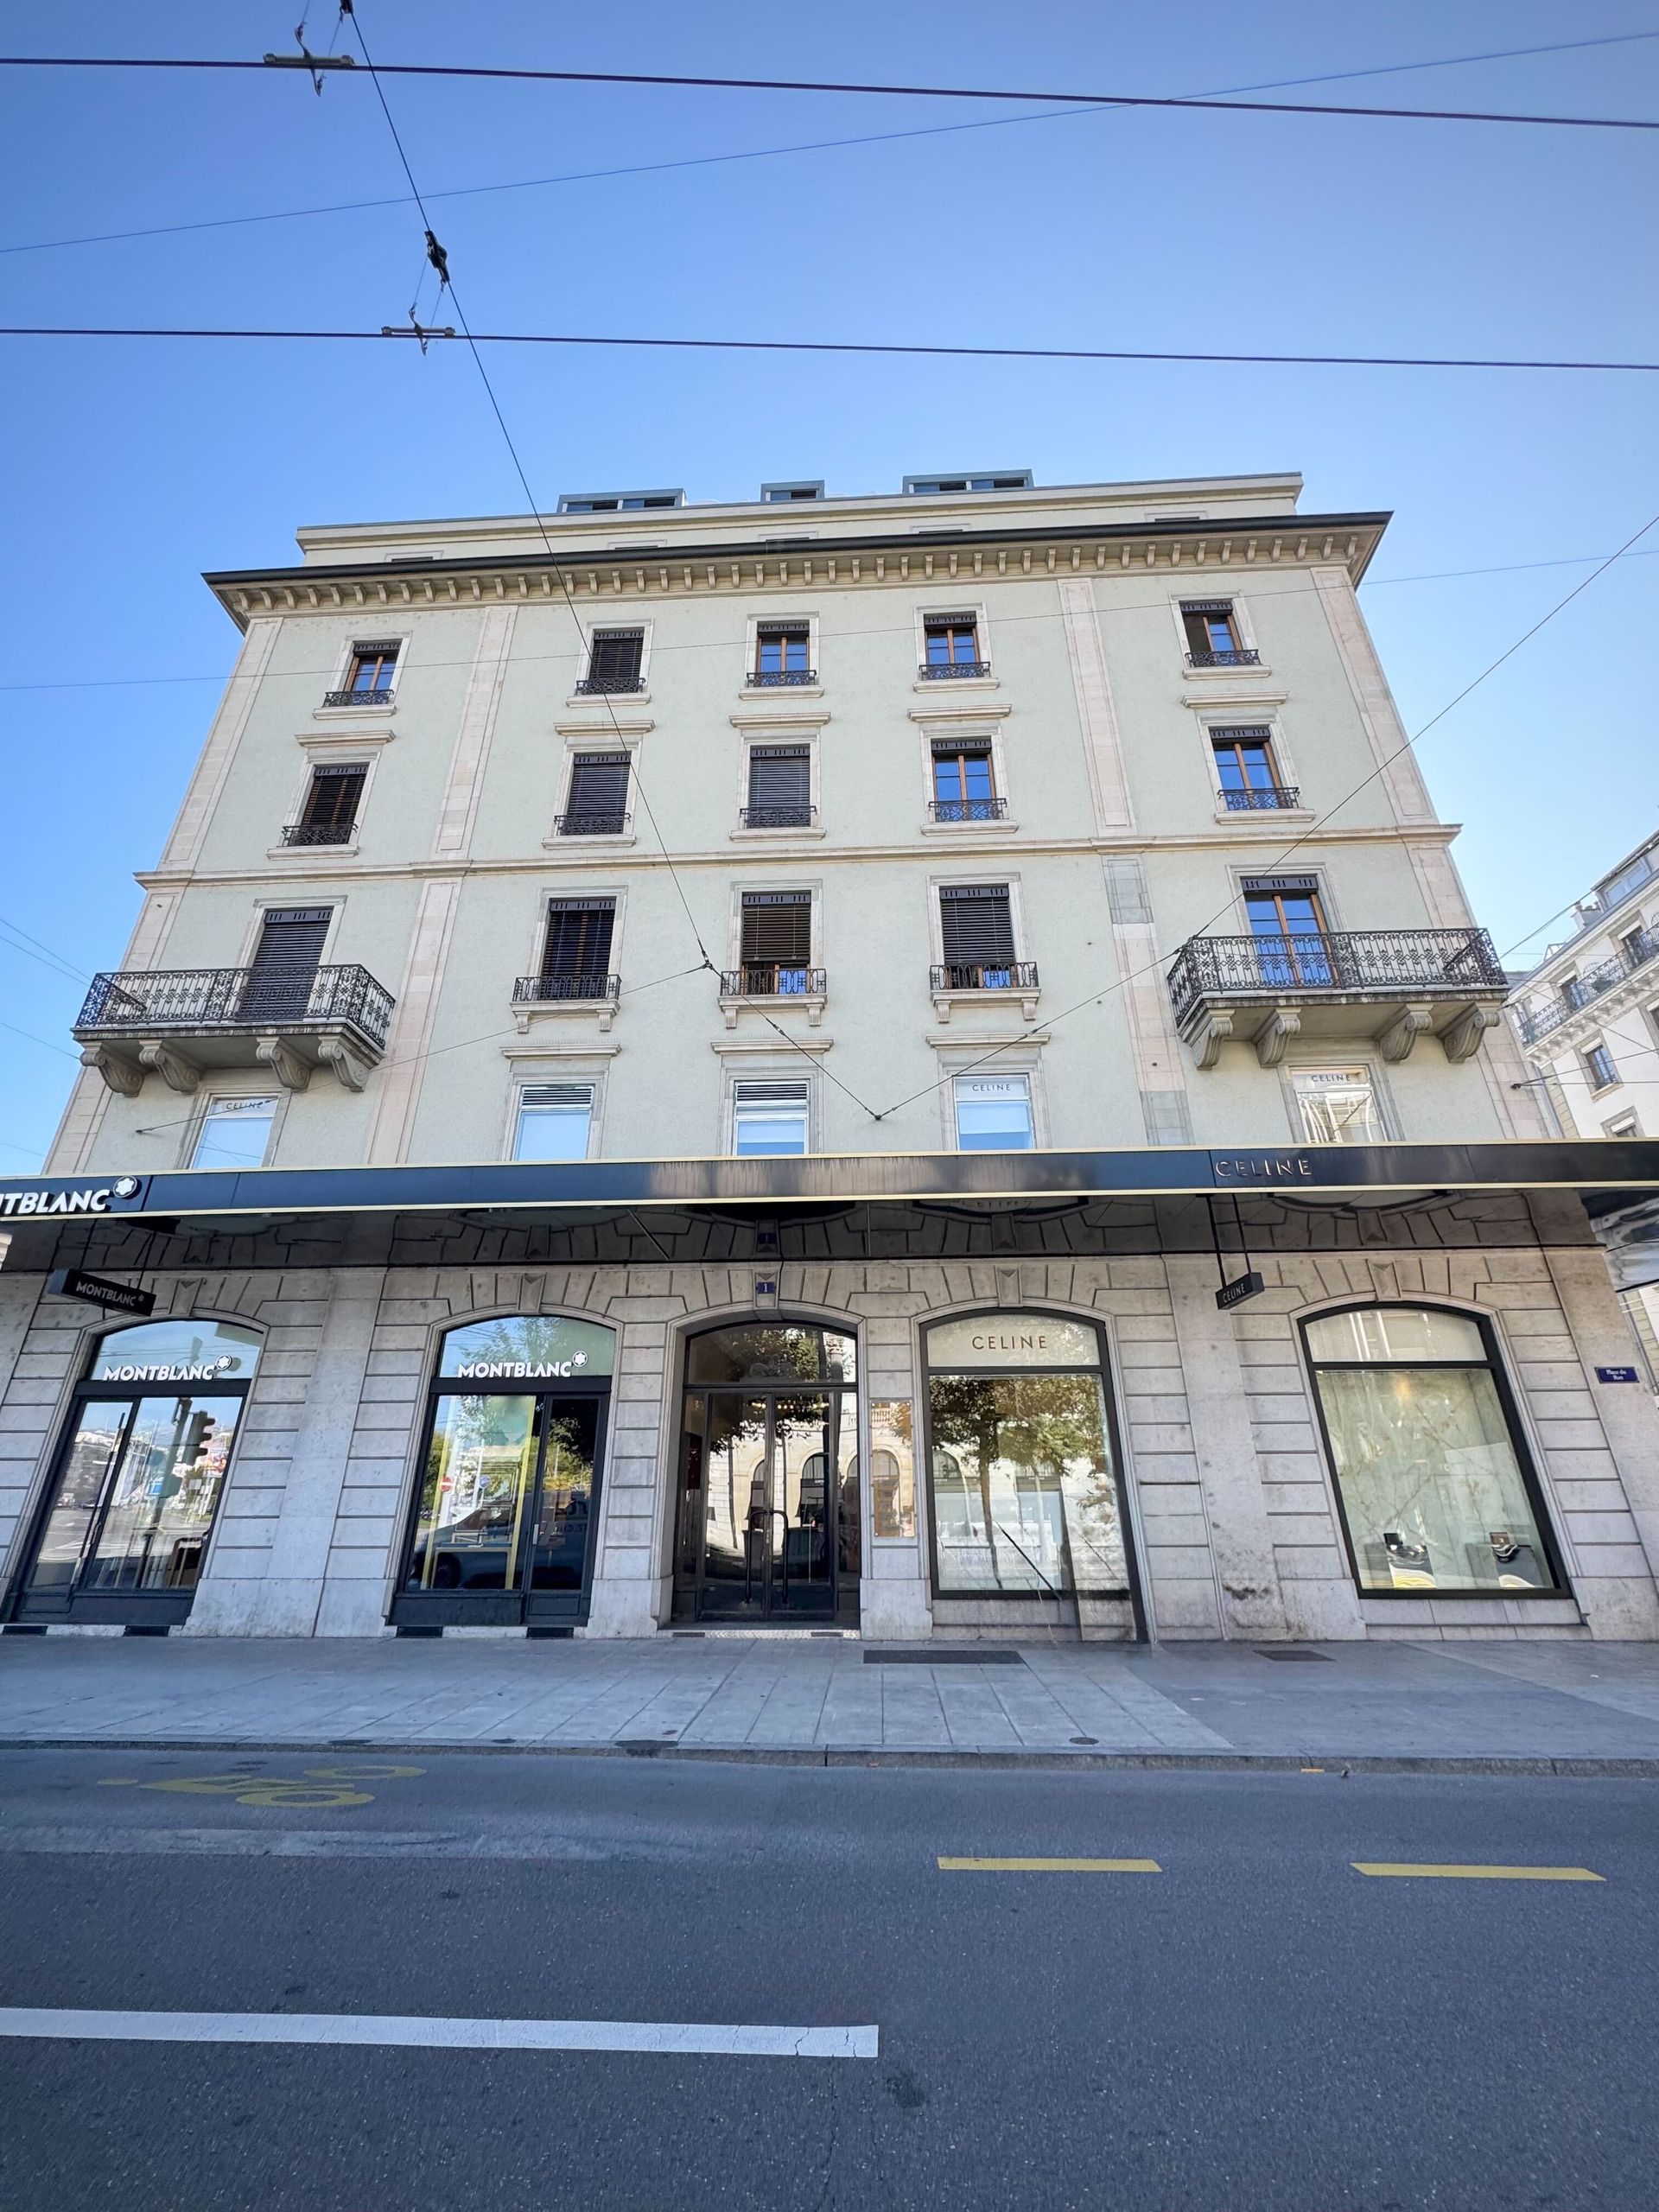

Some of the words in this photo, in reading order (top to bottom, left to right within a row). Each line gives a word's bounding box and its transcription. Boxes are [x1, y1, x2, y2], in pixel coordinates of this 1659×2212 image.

[1311, 1074, 1351, 1083] CELINE
[1216, 1160, 1313, 1177] CELINE
[0, 1189, 110, 1214] TBLANC
[75, 1281, 137, 1307] MONTBLANC
[763, 1283, 768, 1293] 1
[1223, 1282, 1245, 1303] CELINE
[972, 1336, 1048, 1350] CELINE
[102, 1365, 213, 1381] MONTBLANC
[457, 1362, 572, 1378] MONTBLANC
